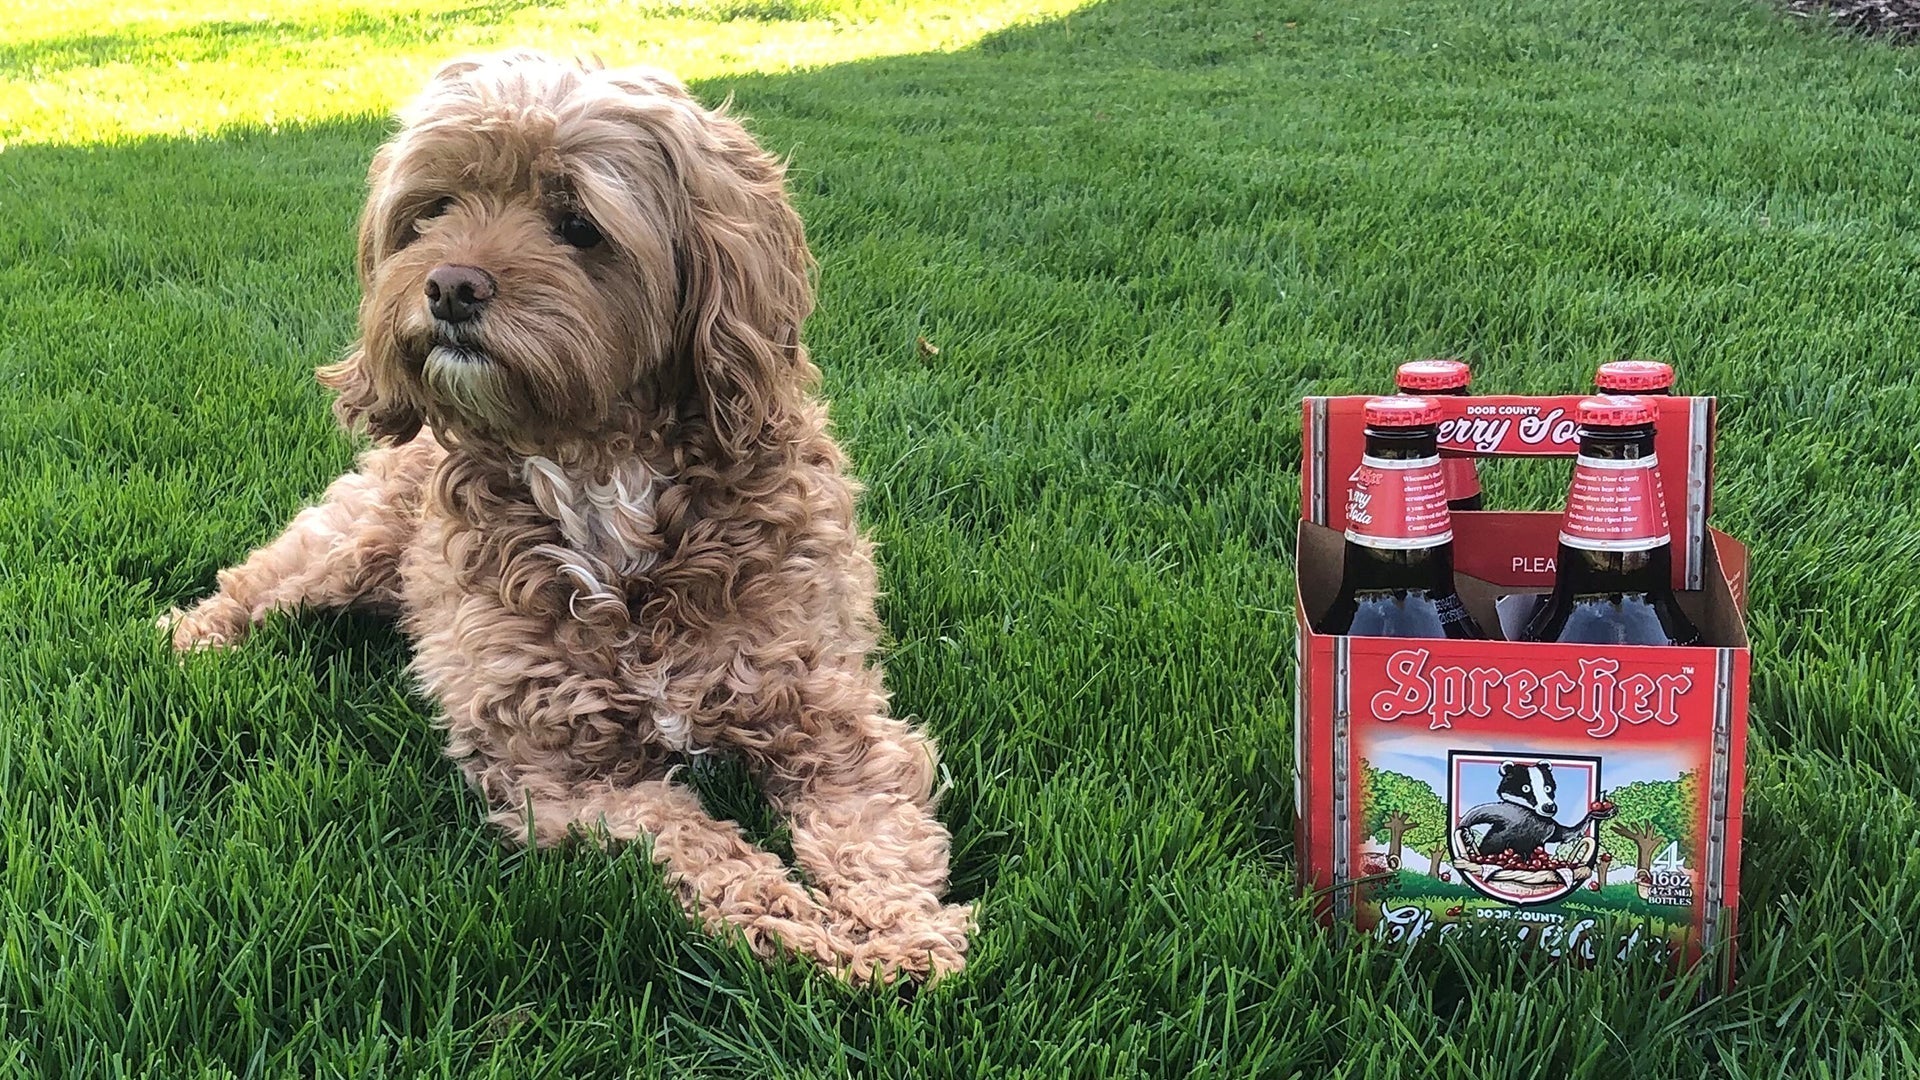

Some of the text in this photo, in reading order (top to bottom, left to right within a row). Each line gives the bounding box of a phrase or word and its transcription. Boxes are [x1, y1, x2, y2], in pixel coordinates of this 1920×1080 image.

[1467, 406, 1542, 415] DOOR COUNTY
[1436, 408, 1581, 452] erry So
[1600, 495, 1615, 503] fruit
[1615, 495, 1628, 503] just
[1595, 505, 1619, 513] selected
[1604, 516, 1622, 524] ripest
[1606, 525, 1620, 533] with
[1512, 557, 1557, 573] PLEA
[1371, 648, 1692, 738] Sprecher
[1652, 840, 1687, 872] 4
[1648, 897, 1692, 905] BOTTLES
